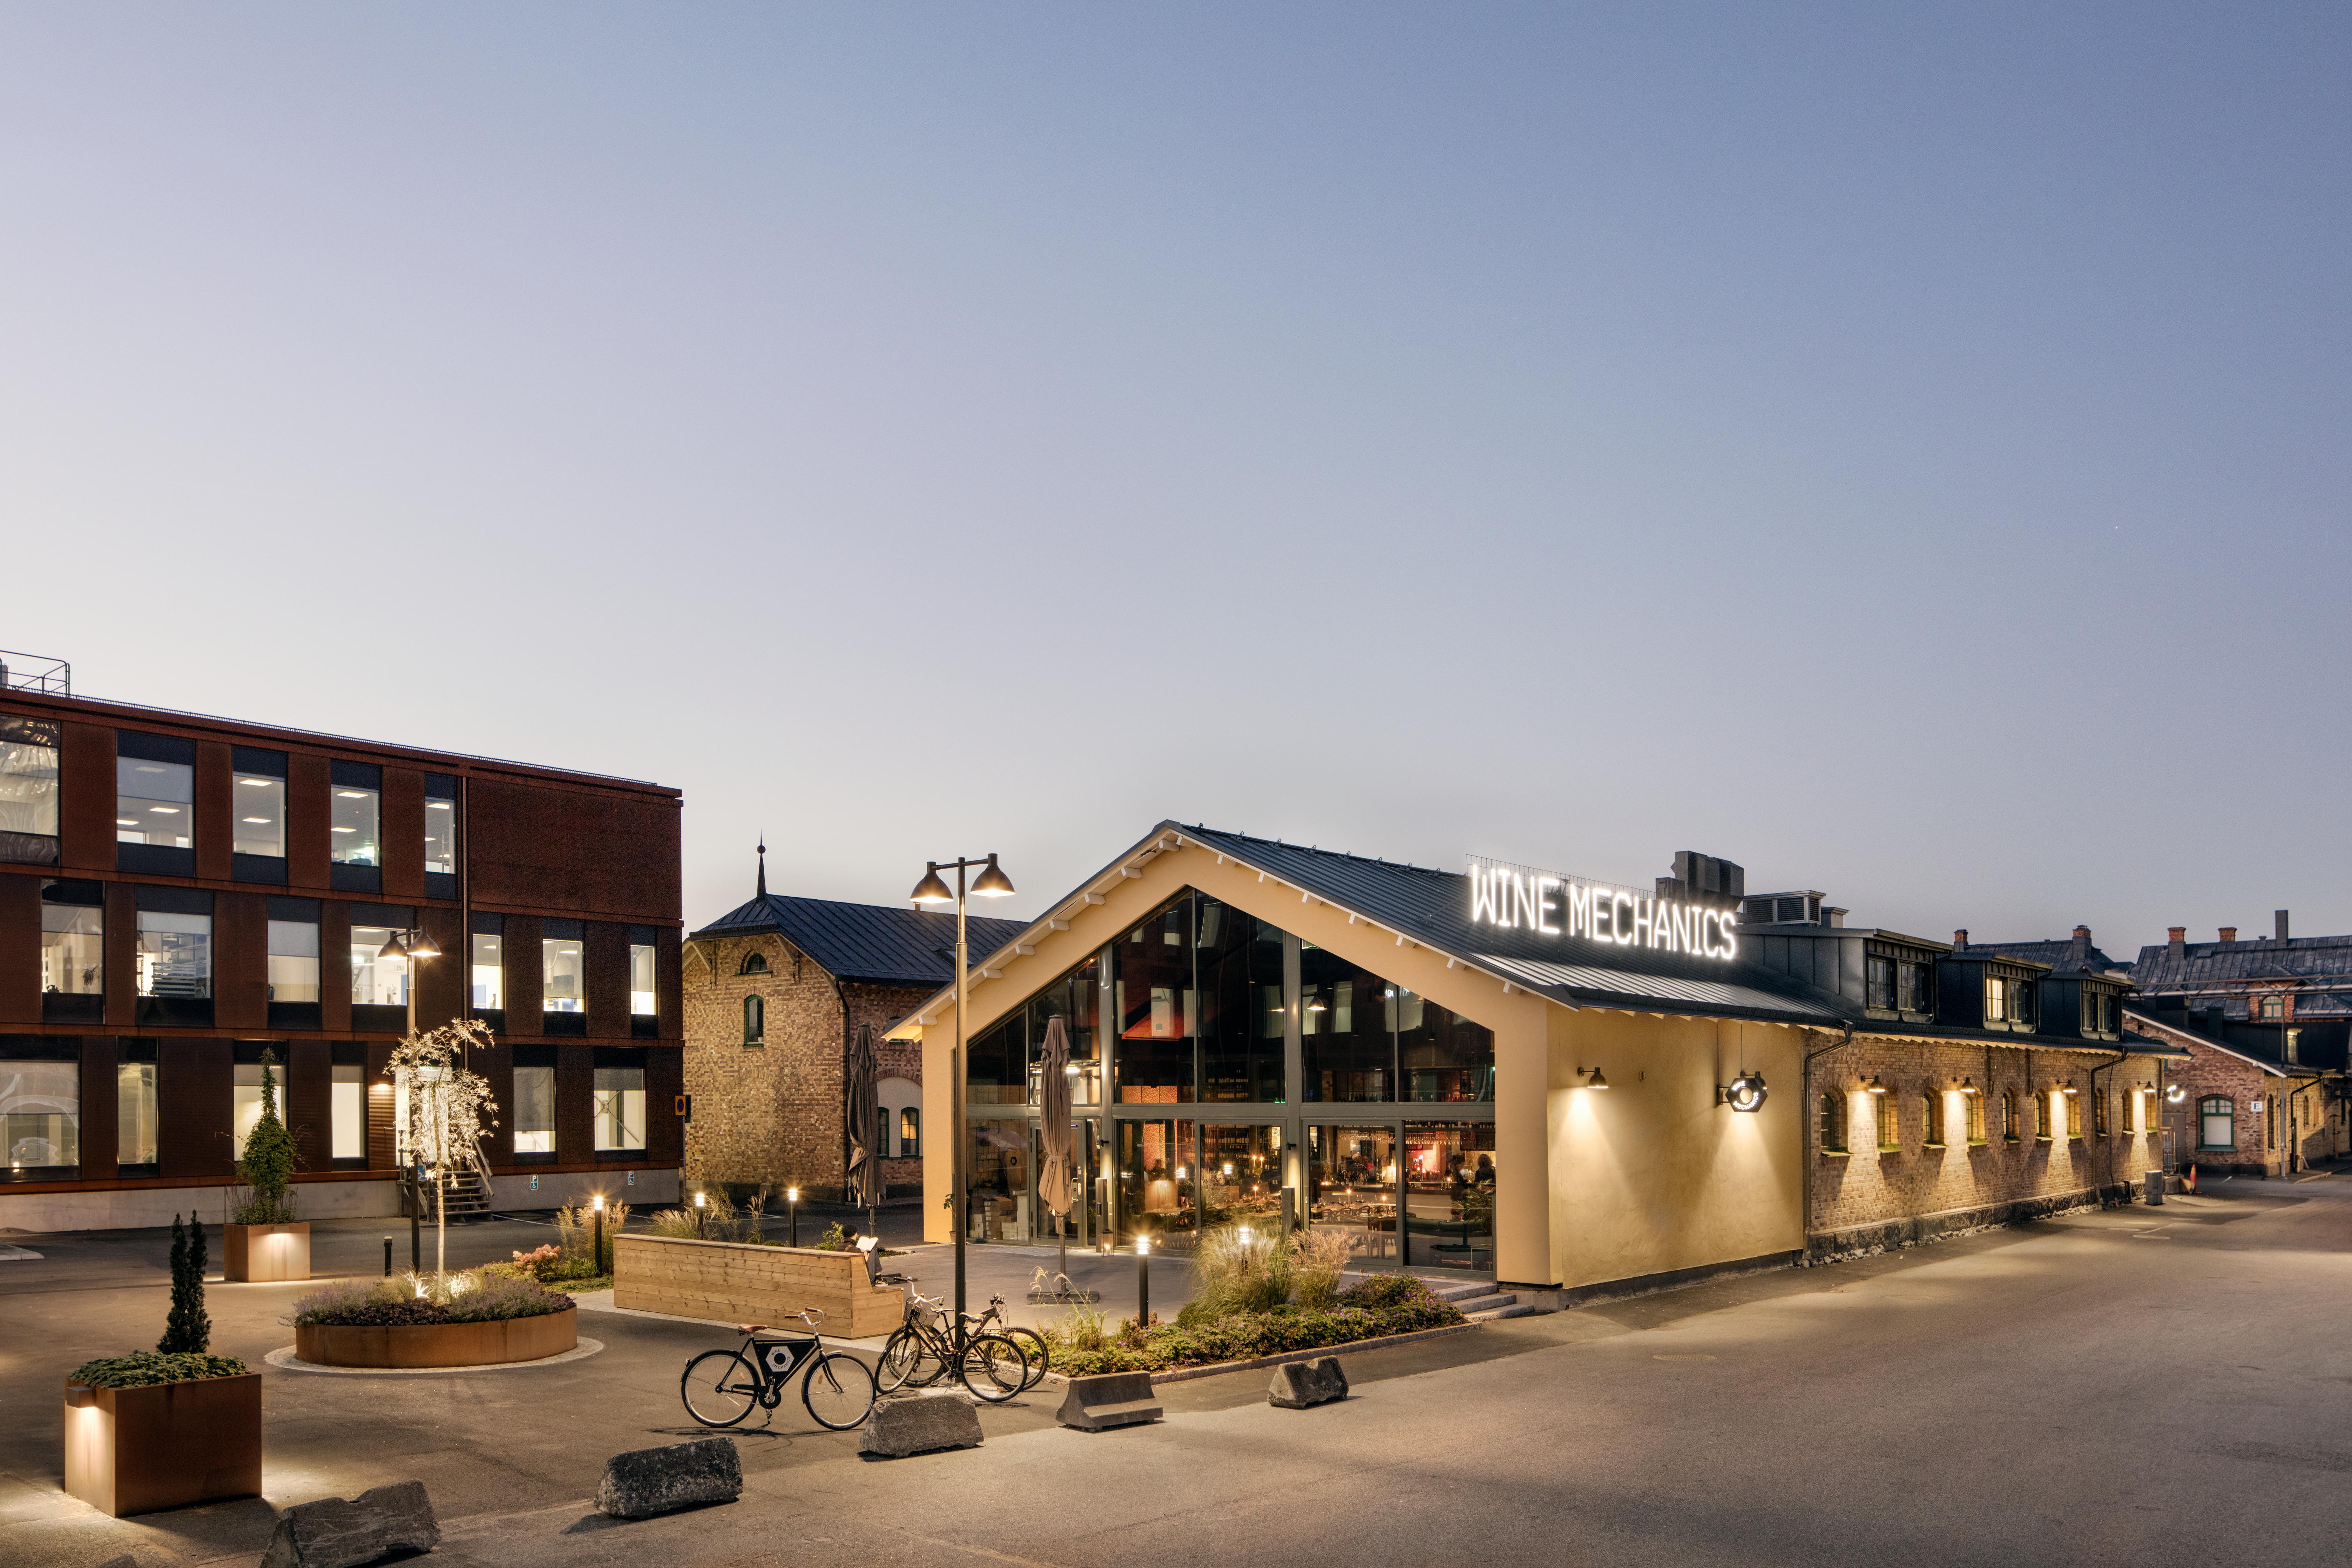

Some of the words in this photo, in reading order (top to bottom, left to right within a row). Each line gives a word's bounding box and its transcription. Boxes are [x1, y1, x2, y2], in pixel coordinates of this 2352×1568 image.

[1472, 864, 1560, 934] WINE
[1570, 883, 1736, 959] MECHANICS
[1732, 1081, 1745, 1091] WINE
[1733, 1092, 1758, 1110] MECHANICS
[772, 1356, 790, 1369] MECHANICS
